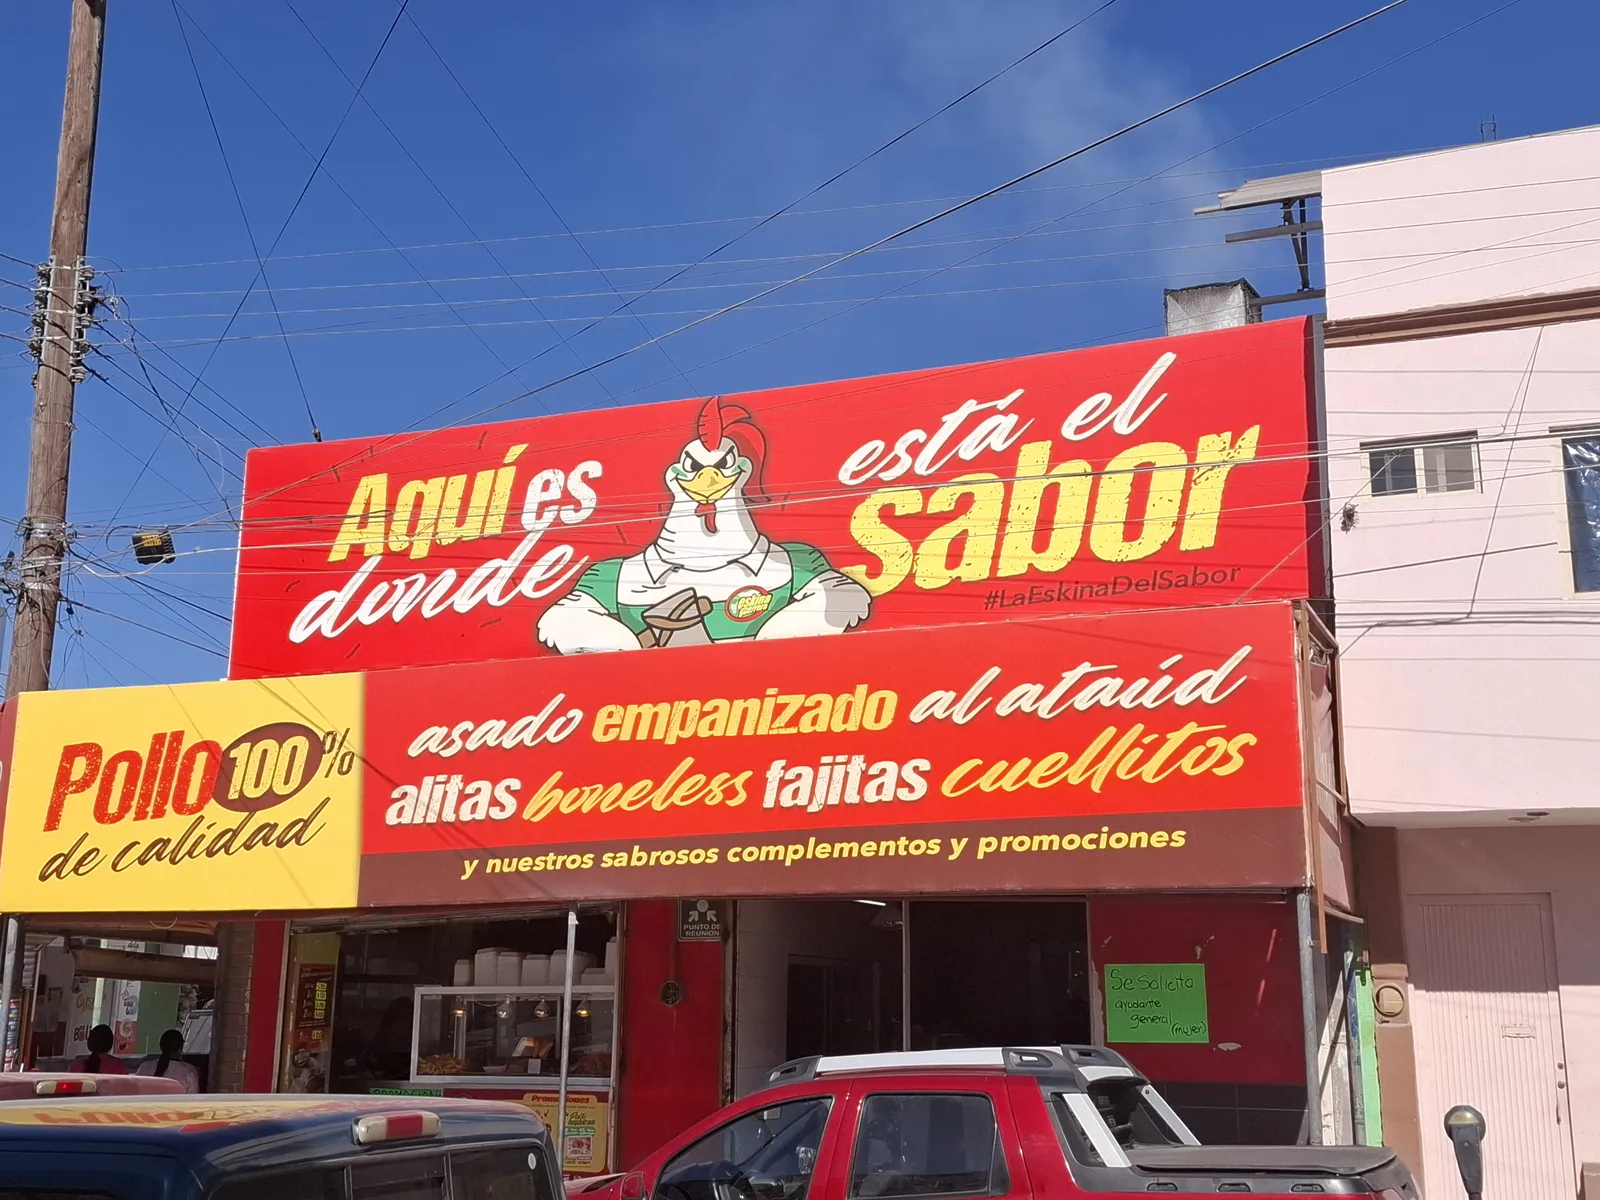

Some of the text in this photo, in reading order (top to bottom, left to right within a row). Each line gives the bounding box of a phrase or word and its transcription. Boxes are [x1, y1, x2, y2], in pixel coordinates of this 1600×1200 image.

[838, 351, 1177, 486] está el
[328, 443, 602, 562] Aquí es
[840, 424, 1260, 597] sabor
[289, 529, 589, 643] donde
[984, 566, 1241, 611] #LaEskinaDelSabor
[407, 645, 1253, 758] asado empanizado al ataúd
[43, 730, 223, 832] Pollo
[385, 721, 1257, 825] alitas boneless fajitas cuellitos
[38, 797, 331, 882] de calidad
[461, 826, 1186, 880] y nuestros sabrosos complementos y promociones
[711, 923, 721, 931] DE
[1110, 968, 1135, 991] Se
[1114, 998, 1162, 1013] ayudante
[1130, 1011, 1173, 1029] general
[1171, 1021, 1208, 1037] (mujer)
